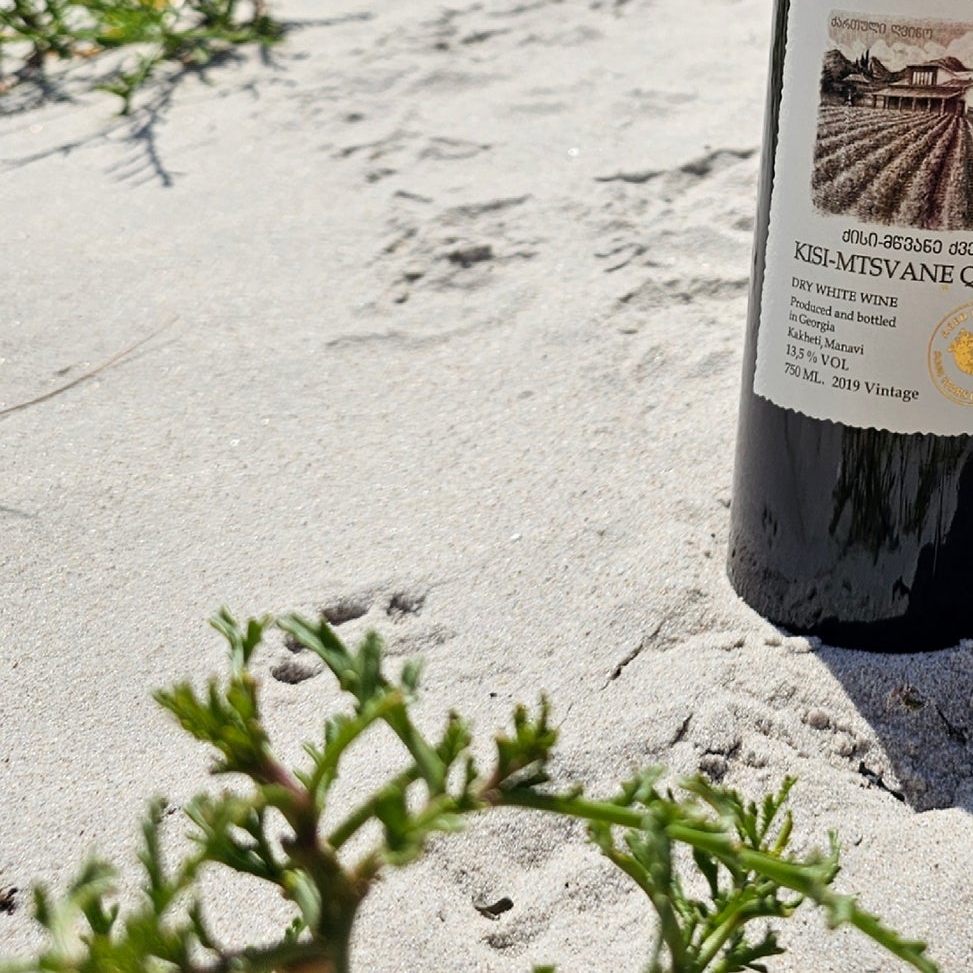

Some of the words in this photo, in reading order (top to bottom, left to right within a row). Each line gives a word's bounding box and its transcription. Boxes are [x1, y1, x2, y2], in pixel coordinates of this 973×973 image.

[793, 240, 954, 284] KISI-MTSVANE
[791, 277, 814, 292] DRY
[816, 283, 857, 302] WHITE
[860, 292, 899, 308] WINE
[789, 310, 798, 322] in
[799, 313, 836, 333] Georgia
[790, 296, 832, 317] Produced
[834, 310, 855, 321] and
[857, 311, 897, 328] bottled
[786, 344, 805, 360] 13,5
[806, 350, 818, 364] %
[821, 354, 849, 371] VOL
[824, 337, 865, 355] Manavi
[784, 362, 801, 378] 750
[802, 368, 825, 385] ML.
[832, 375, 861, 392] 2019
[864, 381, 920, 402] Vintage
